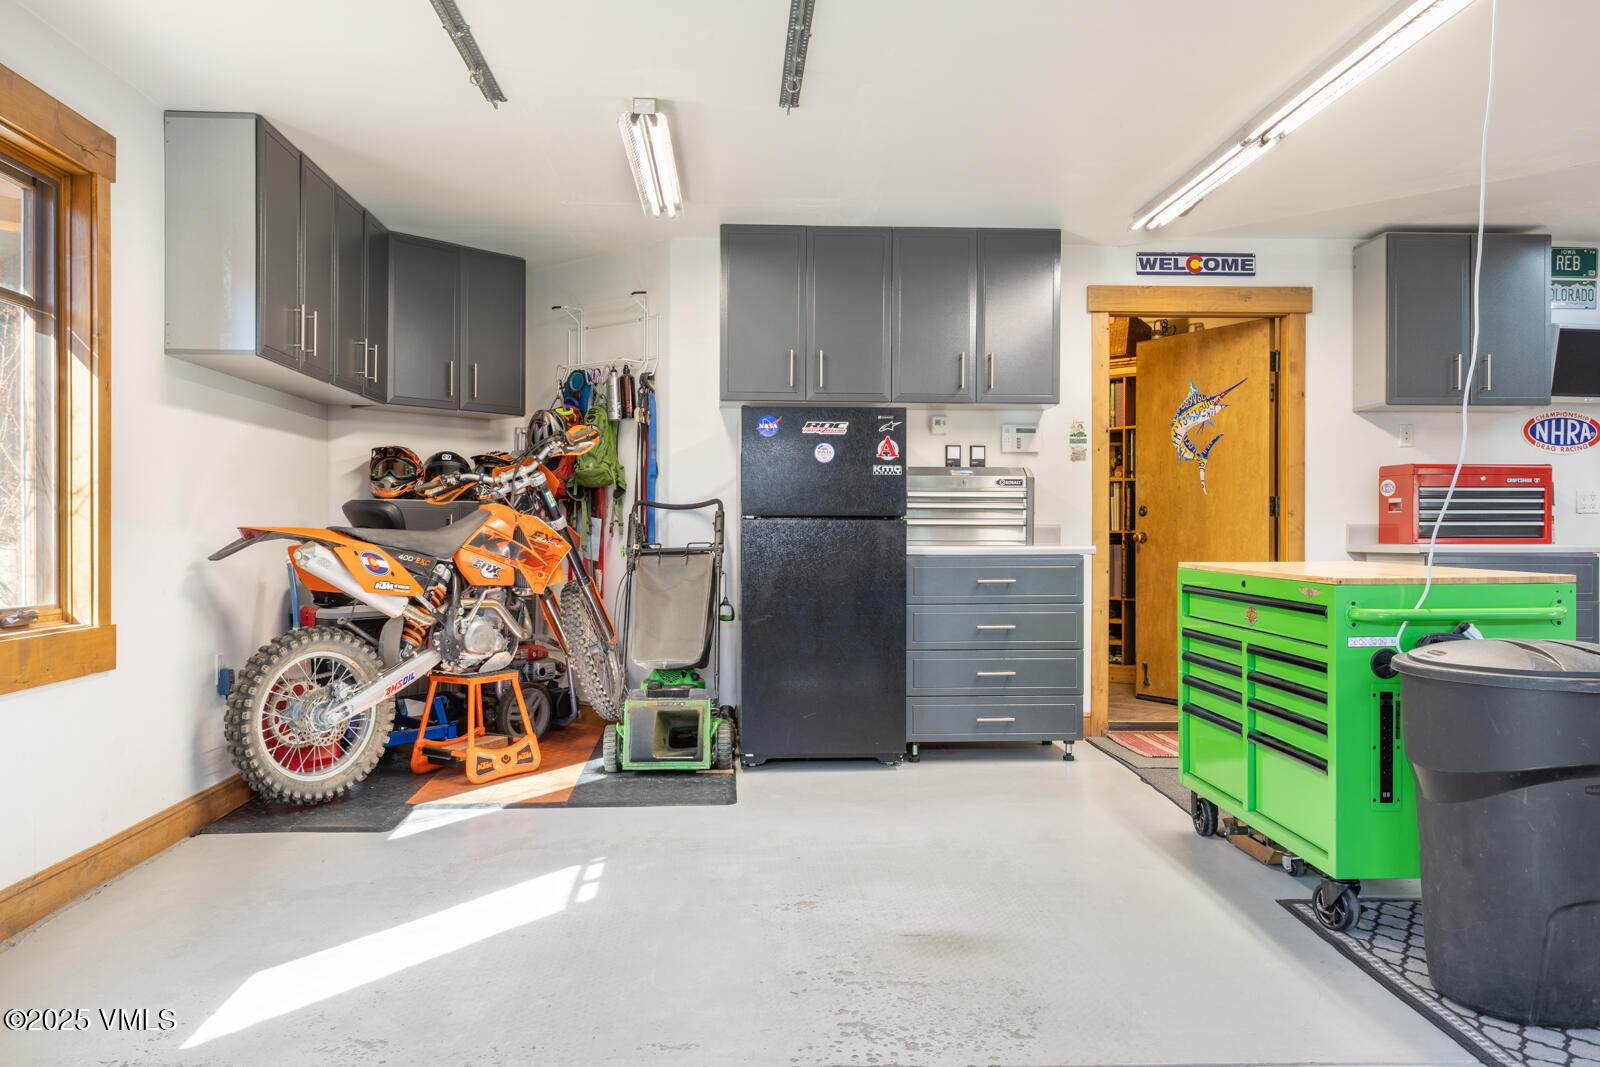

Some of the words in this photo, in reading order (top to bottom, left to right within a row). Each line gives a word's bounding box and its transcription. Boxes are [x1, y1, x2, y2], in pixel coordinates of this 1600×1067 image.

[1138, 254, 1254, 274] WELCOME
[1556, 255, 1581, 271] REB
[1535, 411, 1590, 421] CHAMPIONSHIP
[1535, 419, 1591, 445] NHRA
[1535, 442, 1556, 452] DRAG
[1560, 443, 1588, 452] RACING
[398, 553, 414, 562] 400
[416, 557, 432, 566] EXC
[385, 672, 415, 697] AMSOIL
